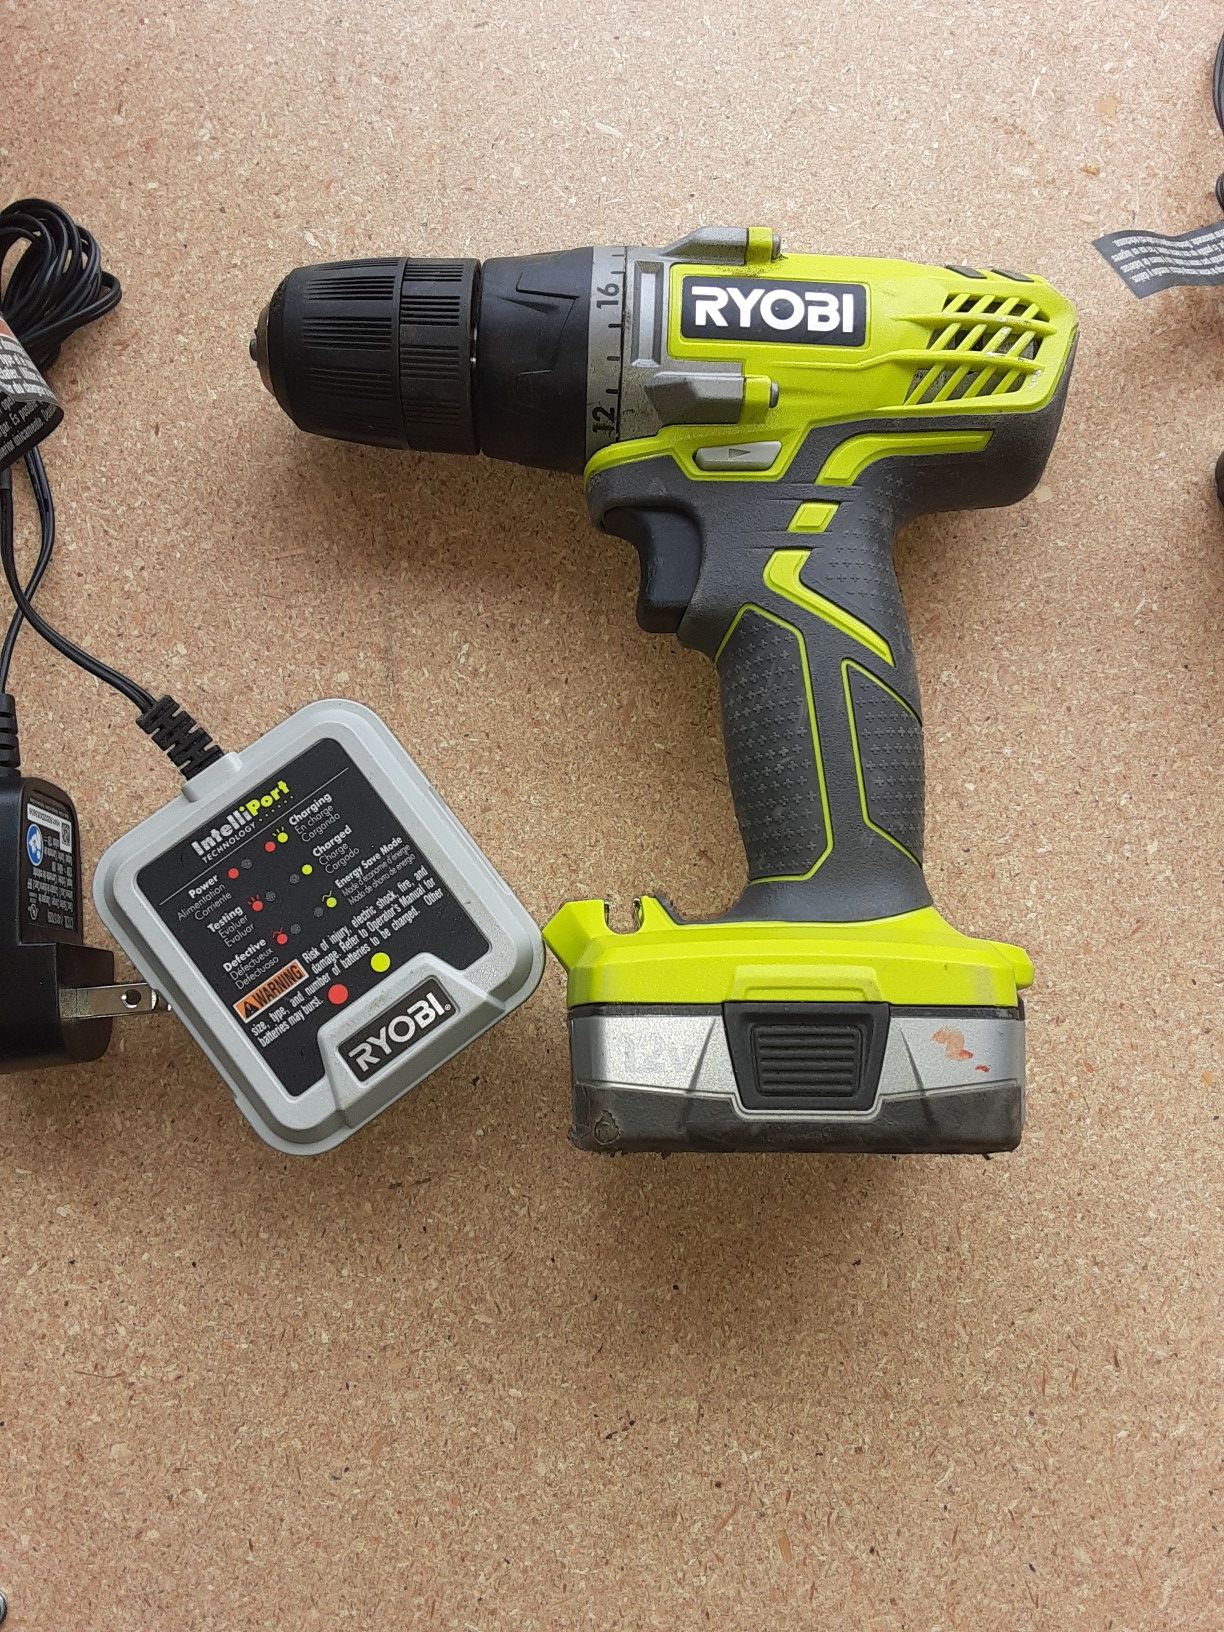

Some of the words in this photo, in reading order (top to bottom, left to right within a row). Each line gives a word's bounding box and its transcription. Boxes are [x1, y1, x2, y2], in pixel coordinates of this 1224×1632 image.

[596, 282, 620, 309] 16
[691, 286, 854, 333] RYOBI
[9, 413, 20, 426] Es
[592, 406, 616, 433] 12
[191, 780, 289, 855] IntelliPort
[288, 793, 332, 828] Charging
[294, 824, 307, 834] En
[307, 801, 333, 826] charge
[301, 812, 340, 842] Cargando
[201, 821, 255, 863] TECHNOLOGY
[312, 824, 352, 857] Charged
[318, 840, 351, 867] Charge
[324, 847, 359, 873] Cargado
[334, 865, 363, 888] Energy
[360, 852, 381, 869] Save
[379, 836, 402, 855] Mode
[188, 874, 218, 898] Power
[340, 882, 359, 896] Mode
[347, 890, 366, 905] Modo
[364, 884, 373, 893] de
[371, 872, 390, 888] ahorro
[388, 866, 397, 875] de
[177, 884, 225, 921] Alimentation
[194, 892, 232, 920] Corriente
[206, 906, 243, 932] Testing
[301, 946, 320, 963] Risk
[319, 938, 329, 951] of
[326, 925, 352, 944] injury,
[350, 905, 376, 928] electric
[375, 889, 399, 909] shock,
[396, 879, 415, 892] fire,
[413, 864, 428, 881] and
[217, 912, 248, 938] Evaluer
[223, 922, 254, 947] Evaluar
[311, 950, 341, 974] damage.
[338, 934, 360, 952] Refer
[357, 928, 368, 938] to
[365, 903, 401, 932] Operator's
[397, 883, 426, 908] Manual
[422, 877, 435, 889] for
[222, 939, 266, 972] Defective
[250, 1020, 270, 1036] size,
[268, 1006, 290, 1025] type,
[287, 990, 305, 1007] and
[304, 972, 331, 996] number
[331, 962, 341, 976] of
[339, 943, 371, 968] batteries
[369, 936, 380, 946] to
[377, 927, 391, 939] be
[390, 905, 420, 931] charged.
[423, 887, 443, 905] Other
[234, 956, 279, 989] Defectuoso
[253, 967, 301, 1006] WARNING
[257, 1020, 290, 1047] batteries
[287, 1009, 305, 1026] may
[300, 995, 324, 1015] burst.
[348, 991, 445, 1071] RYOBI
